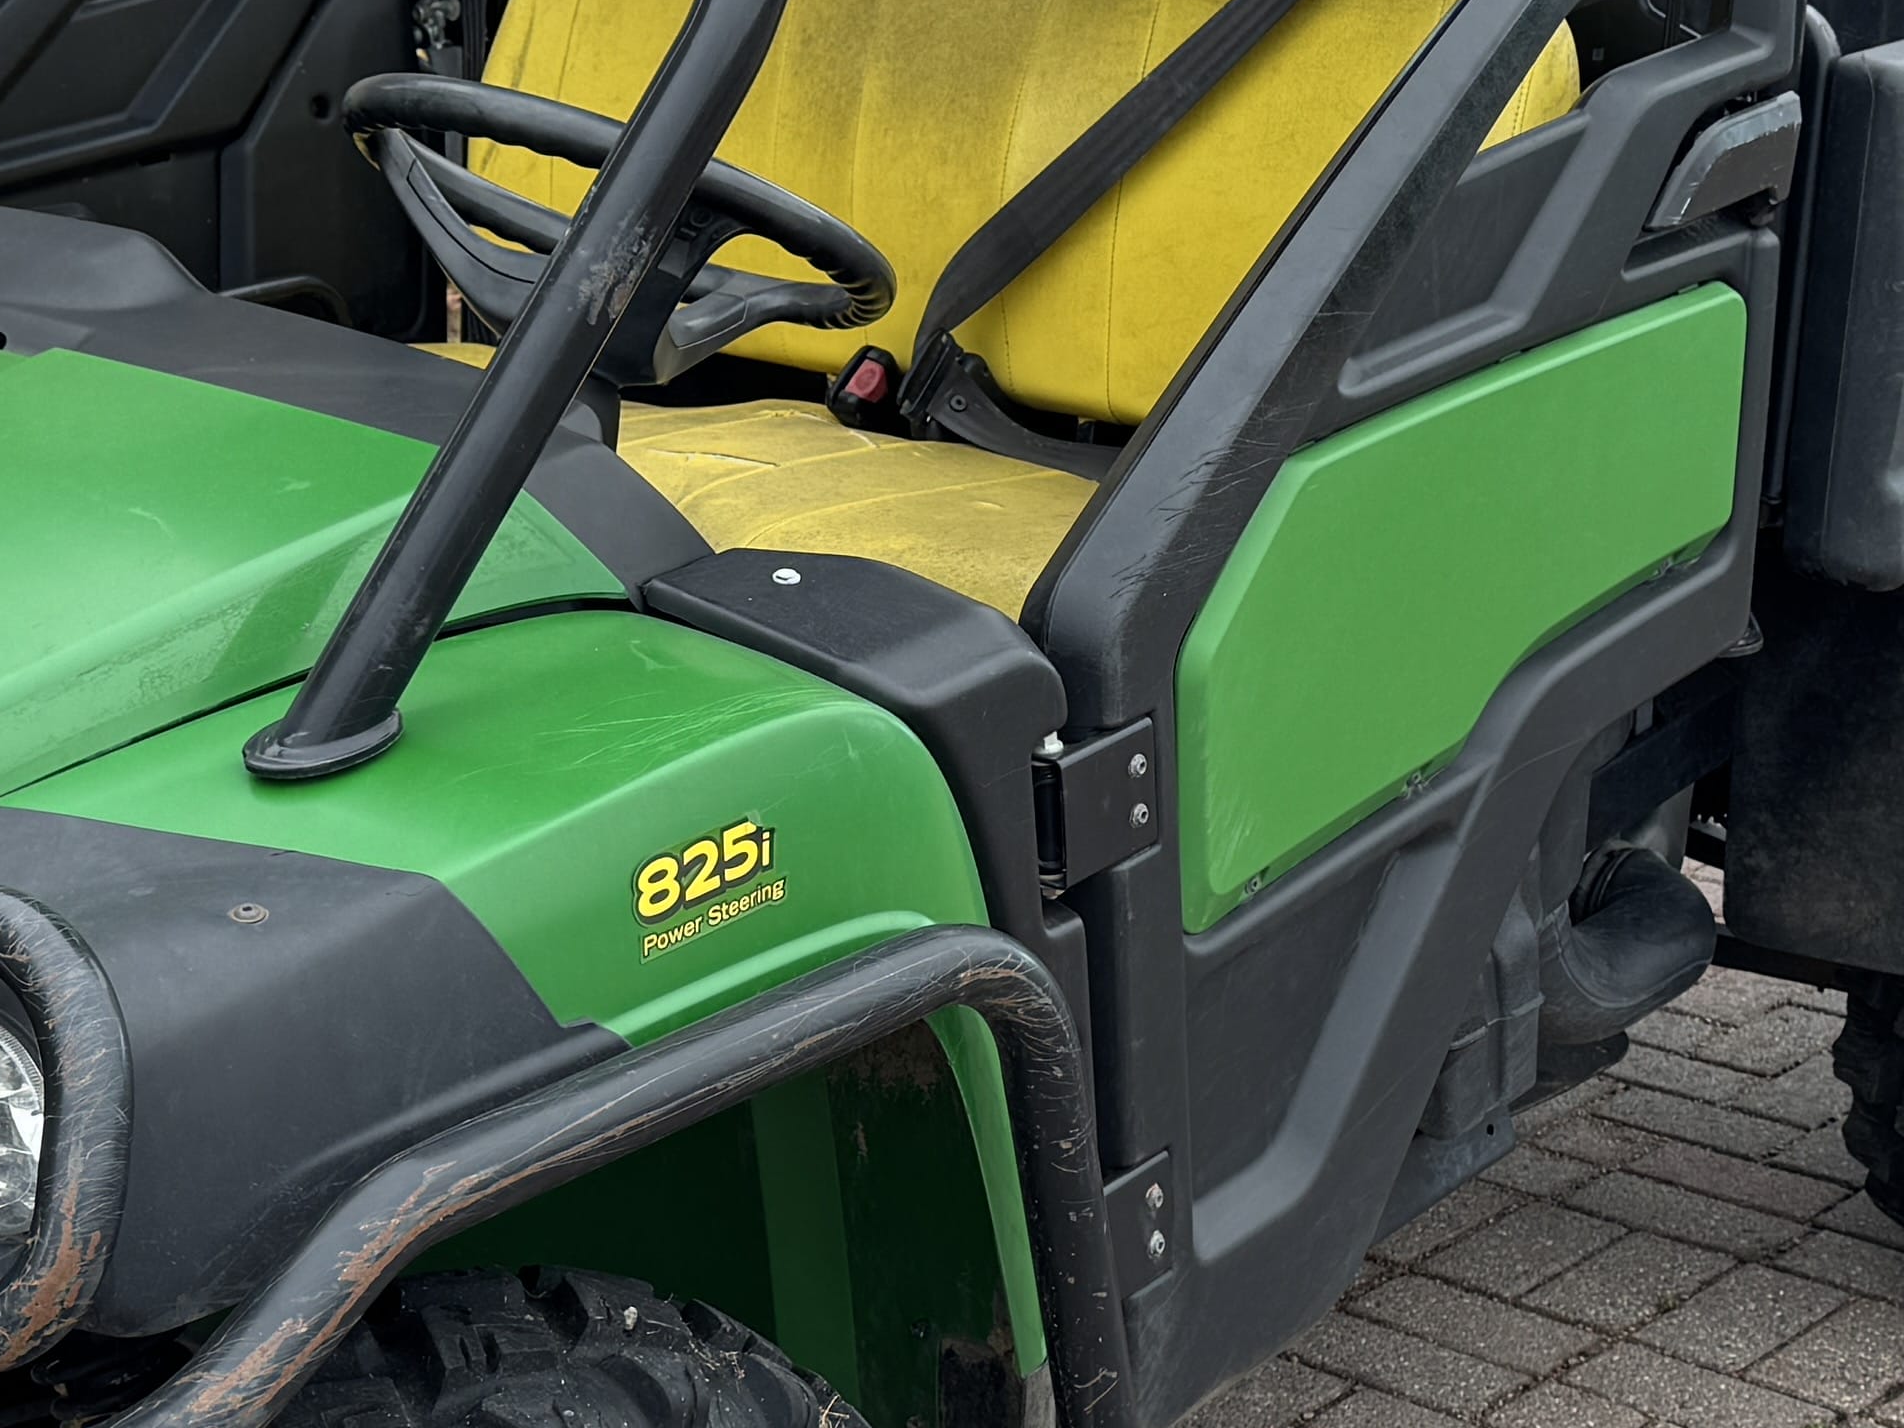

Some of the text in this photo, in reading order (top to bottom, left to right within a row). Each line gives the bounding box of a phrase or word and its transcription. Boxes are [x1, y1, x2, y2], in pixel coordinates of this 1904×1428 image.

[635, 818, 774, 920] 825i
[643, 876, 787, 958] Power Steering
